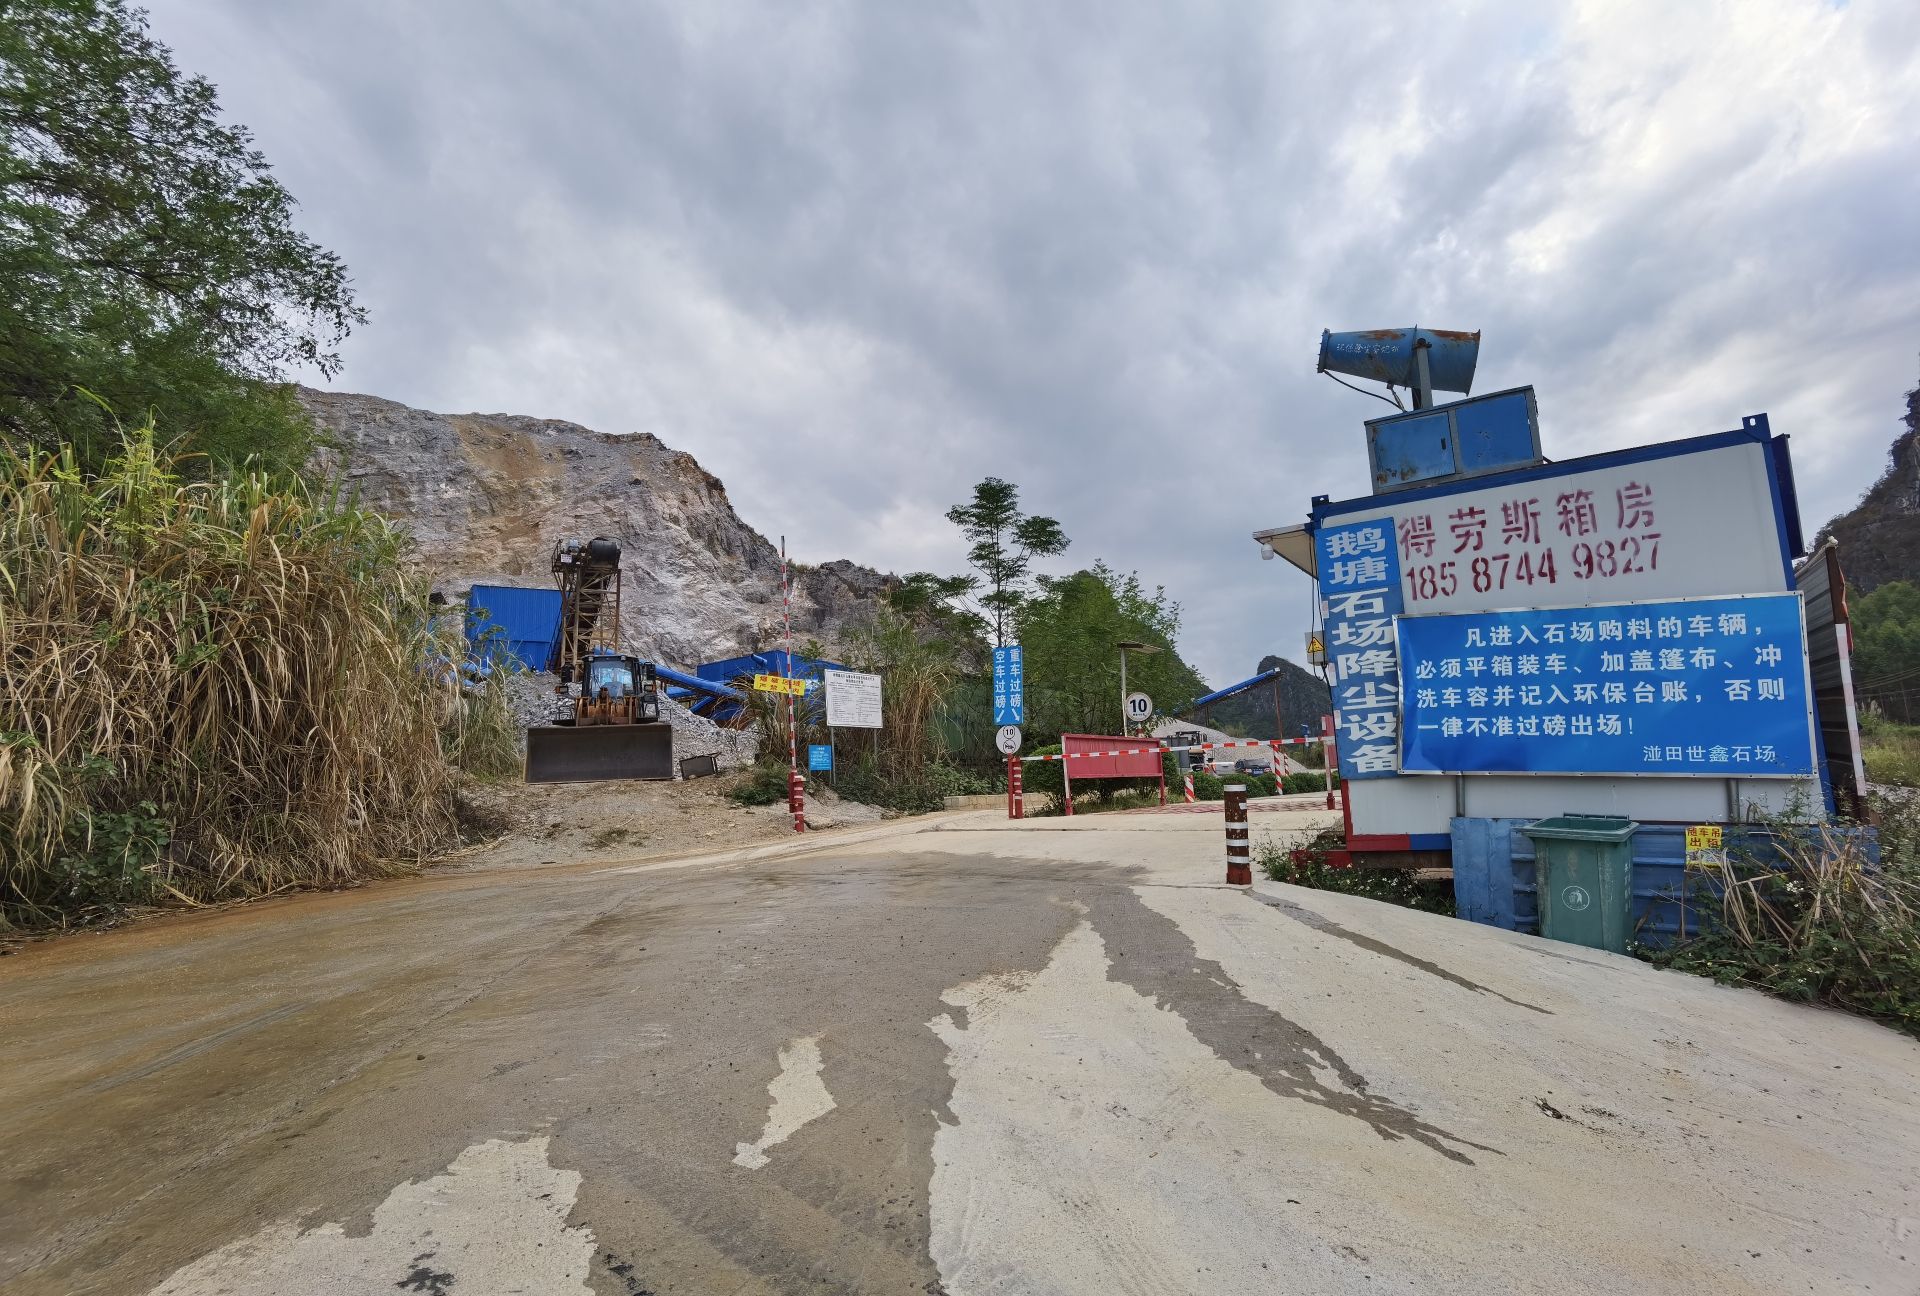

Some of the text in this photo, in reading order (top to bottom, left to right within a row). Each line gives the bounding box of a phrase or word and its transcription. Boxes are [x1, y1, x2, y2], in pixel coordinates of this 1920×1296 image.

[1398, 481, 1656, 561] 得劳斯箱房
[1405, 533, 1662, 601] 185 8744 9827
[1326, 527, 1397, 774] 鹅塘石场降尘设备
[1465, 613, 1762, 648] 凡进入石场购料的车辆，
[995, 650, 1006, 709] 空车过磅
[1009, 648, 1021, 708] 重车过磅
[1130, 698, 1148, 713] 10
[1005, 728, 1014, 736] 10
[1417, 714, 1633, 737] 一律不准过磅出场！
